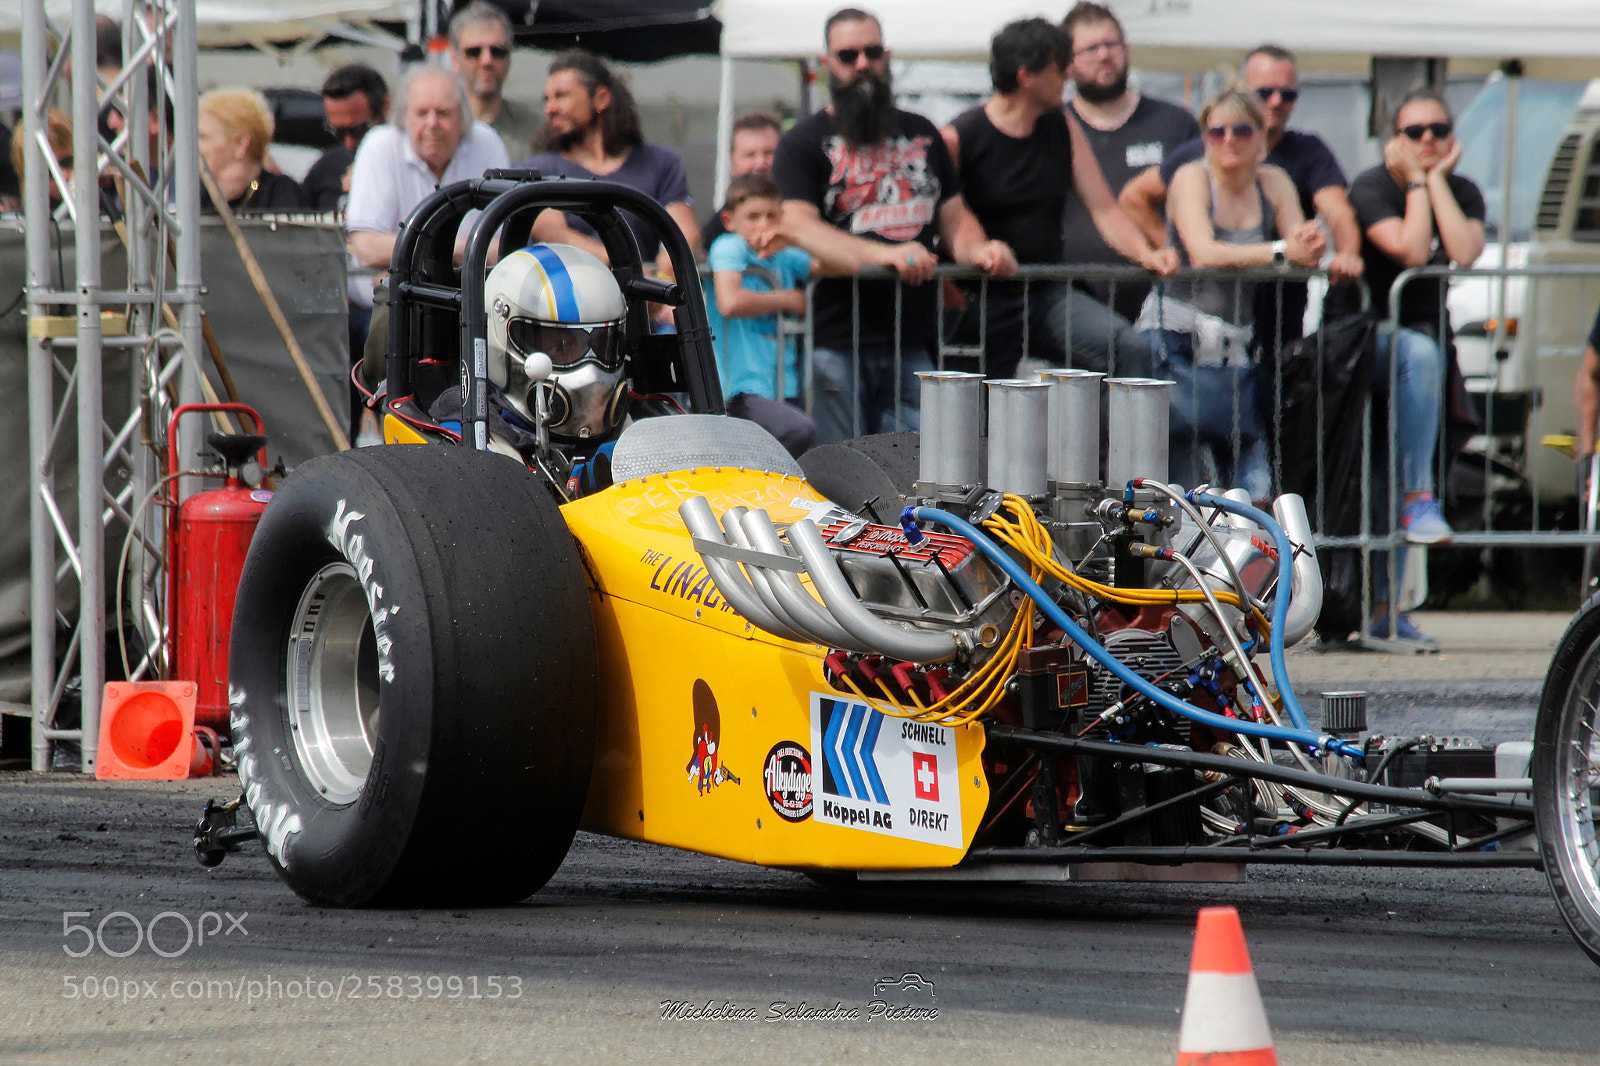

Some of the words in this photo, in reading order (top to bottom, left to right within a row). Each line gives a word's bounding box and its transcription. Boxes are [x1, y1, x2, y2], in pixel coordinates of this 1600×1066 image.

[616, 478, 710, 517] PER
[877, 530, 909, 543] Mopa
[640, 548, 664, 567] THE
[901, 721, 947, 746] SCHNELL
[823, 799, 870, 826] Köppel
[872, 810, 893, 830] AG
[909, 807, 949, 832] DIREKT
